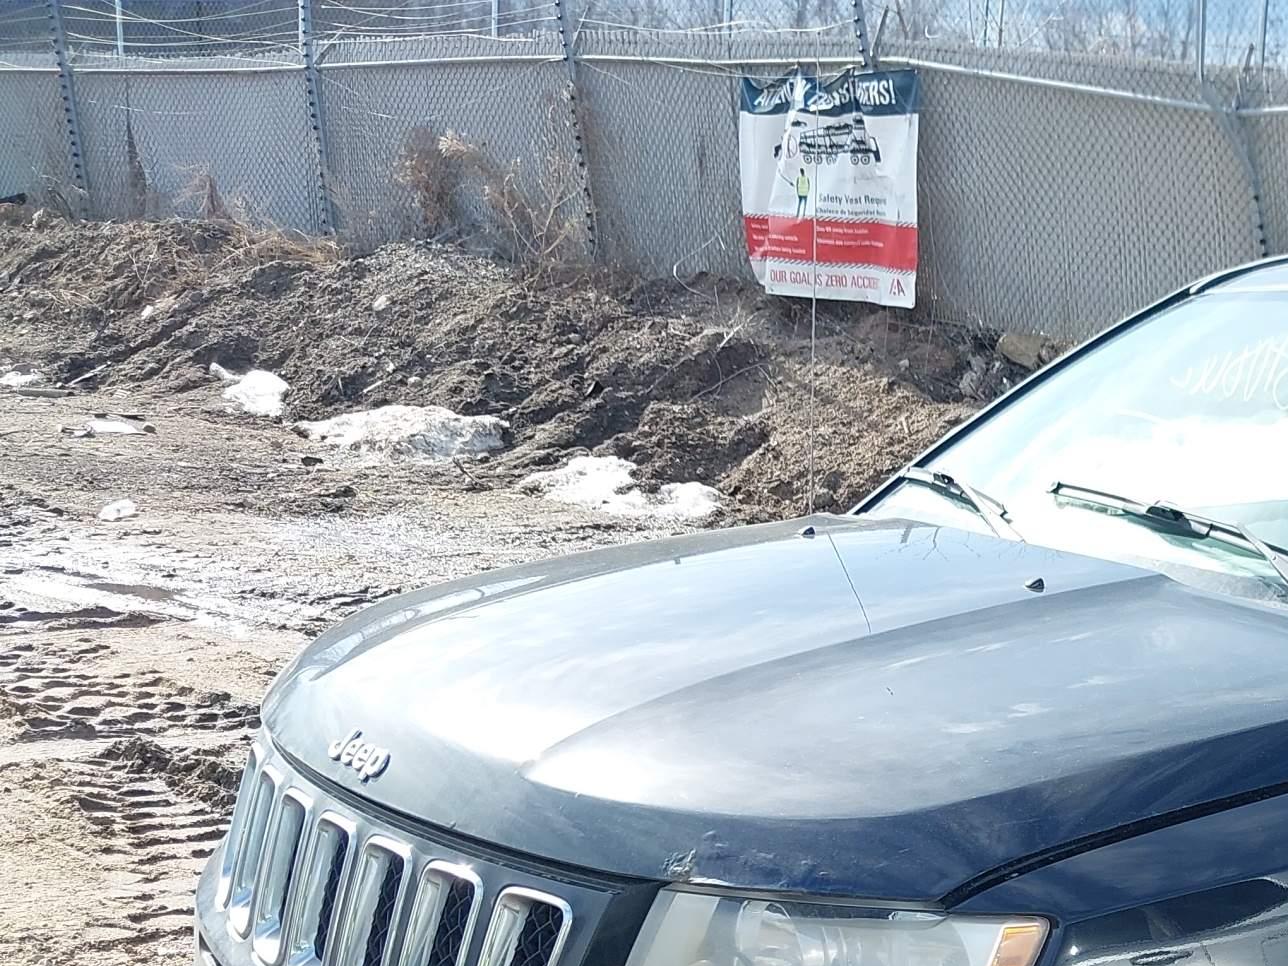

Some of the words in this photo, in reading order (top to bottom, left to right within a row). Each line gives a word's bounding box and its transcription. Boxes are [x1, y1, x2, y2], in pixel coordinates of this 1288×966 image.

[770, 269, 787, 284] OUR
[790, 270, 813, 286] GOAL
[825, 273, 848, 289] ZERO
[327, 727, 391, 785] Jeep
